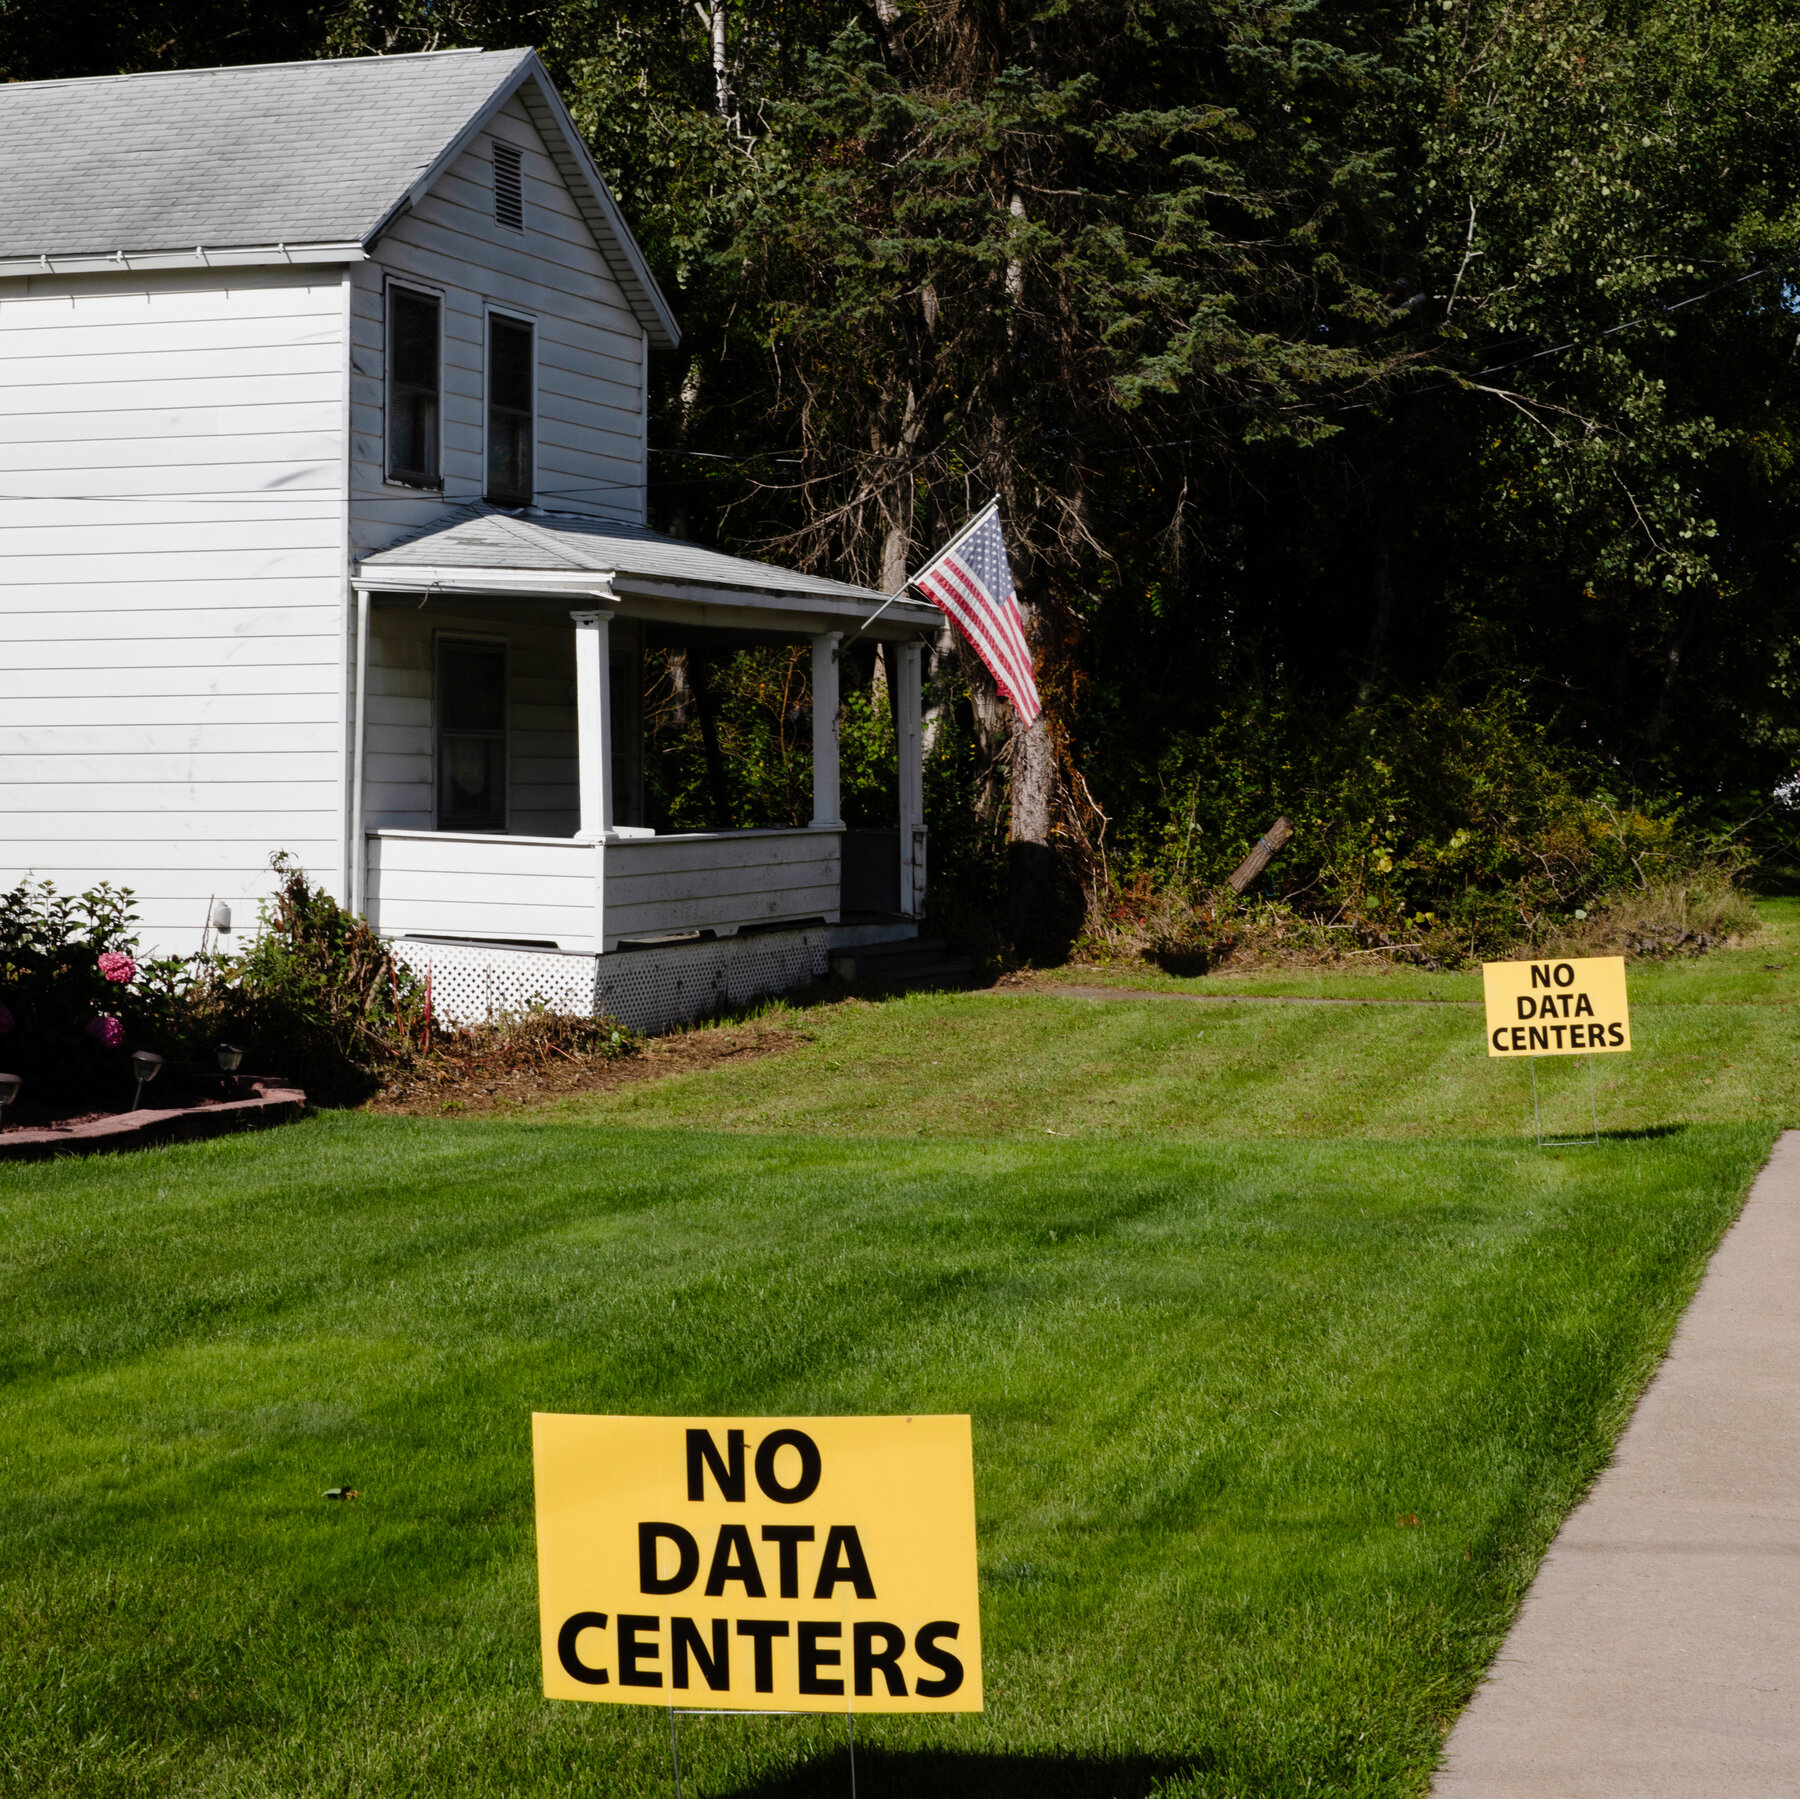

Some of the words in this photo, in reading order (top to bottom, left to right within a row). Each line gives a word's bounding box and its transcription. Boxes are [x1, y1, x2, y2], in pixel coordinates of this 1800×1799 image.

[1531, 963, 1575, 989] NO
[1517, 993, 1594, 1020] DATA
[1492, 1022, 1624, 1052] CENTERS
[685, 1428, 822, 1504] NO
[638, 1521, 877, 1599] DATA
[557, 1611, 964, 1698] CENTERS
